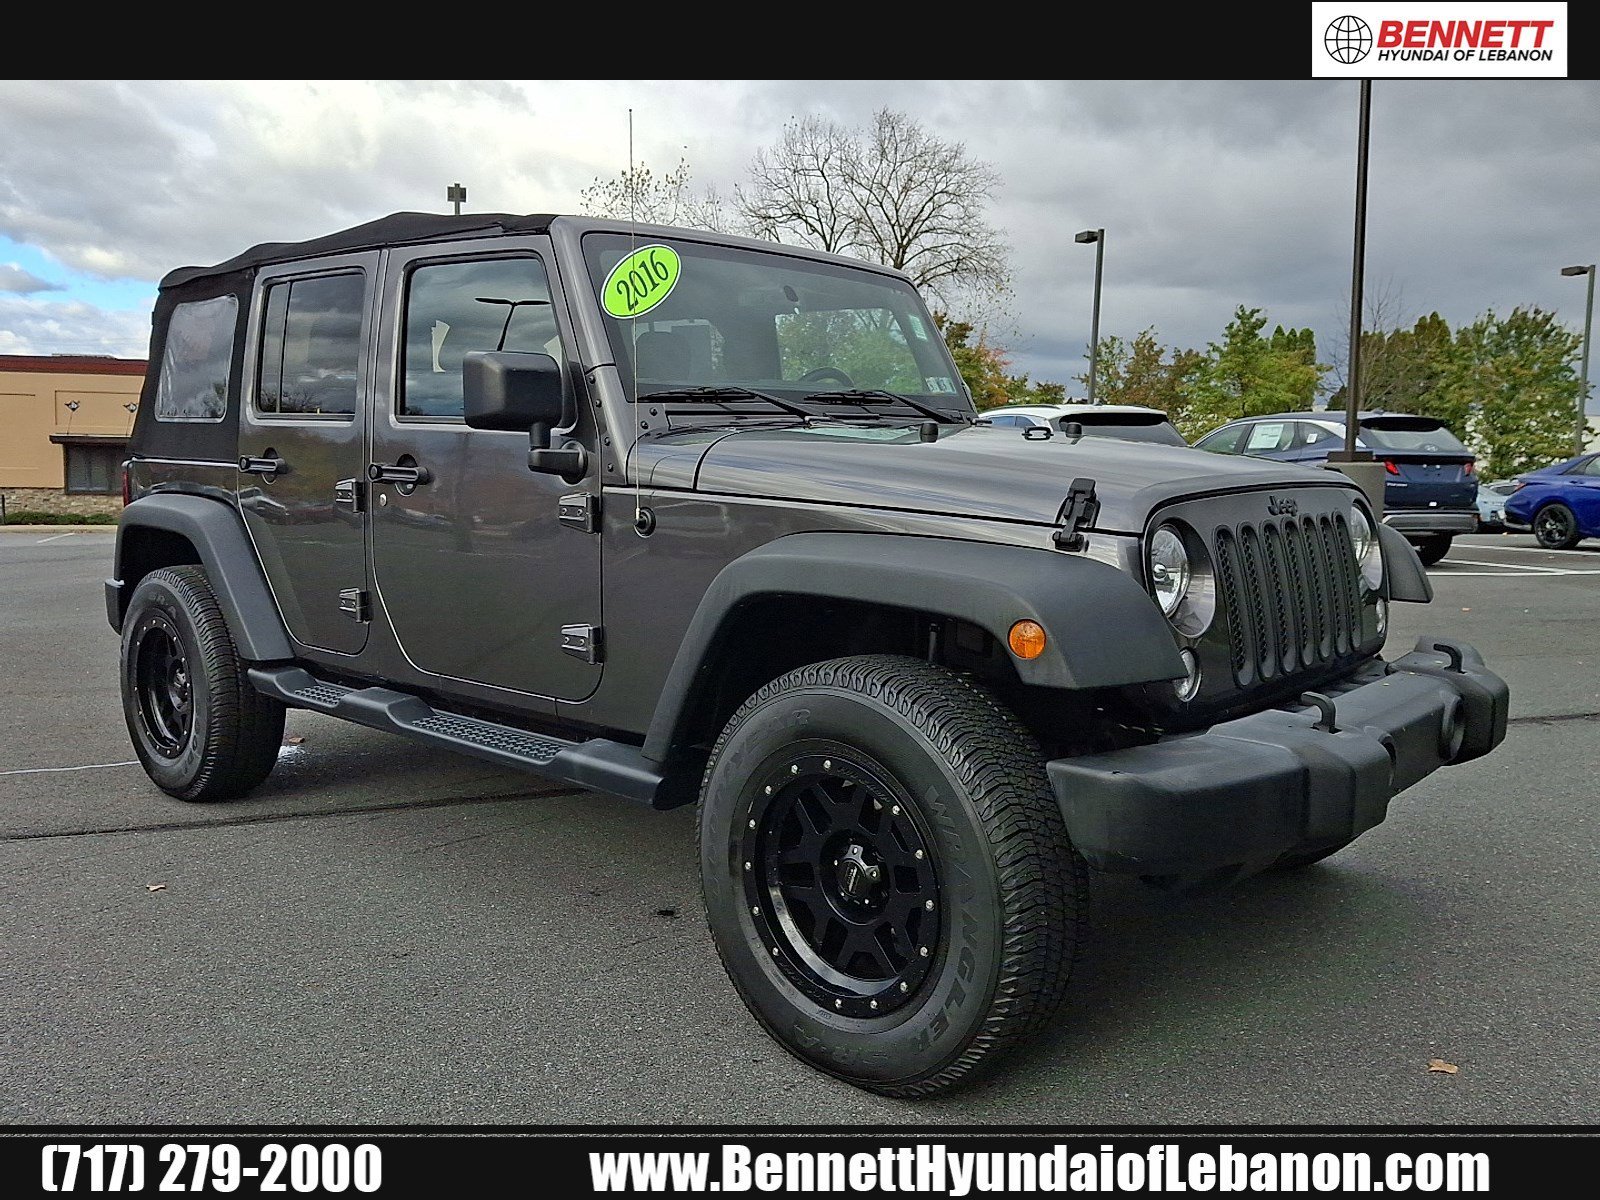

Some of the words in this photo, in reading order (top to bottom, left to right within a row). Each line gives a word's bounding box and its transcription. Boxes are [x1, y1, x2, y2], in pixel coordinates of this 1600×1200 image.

[616, 249, 669, 312] 2016
[1267, 495, 1298, 517] Jeep
[913, 785, 978, 1054] WRANGLER
